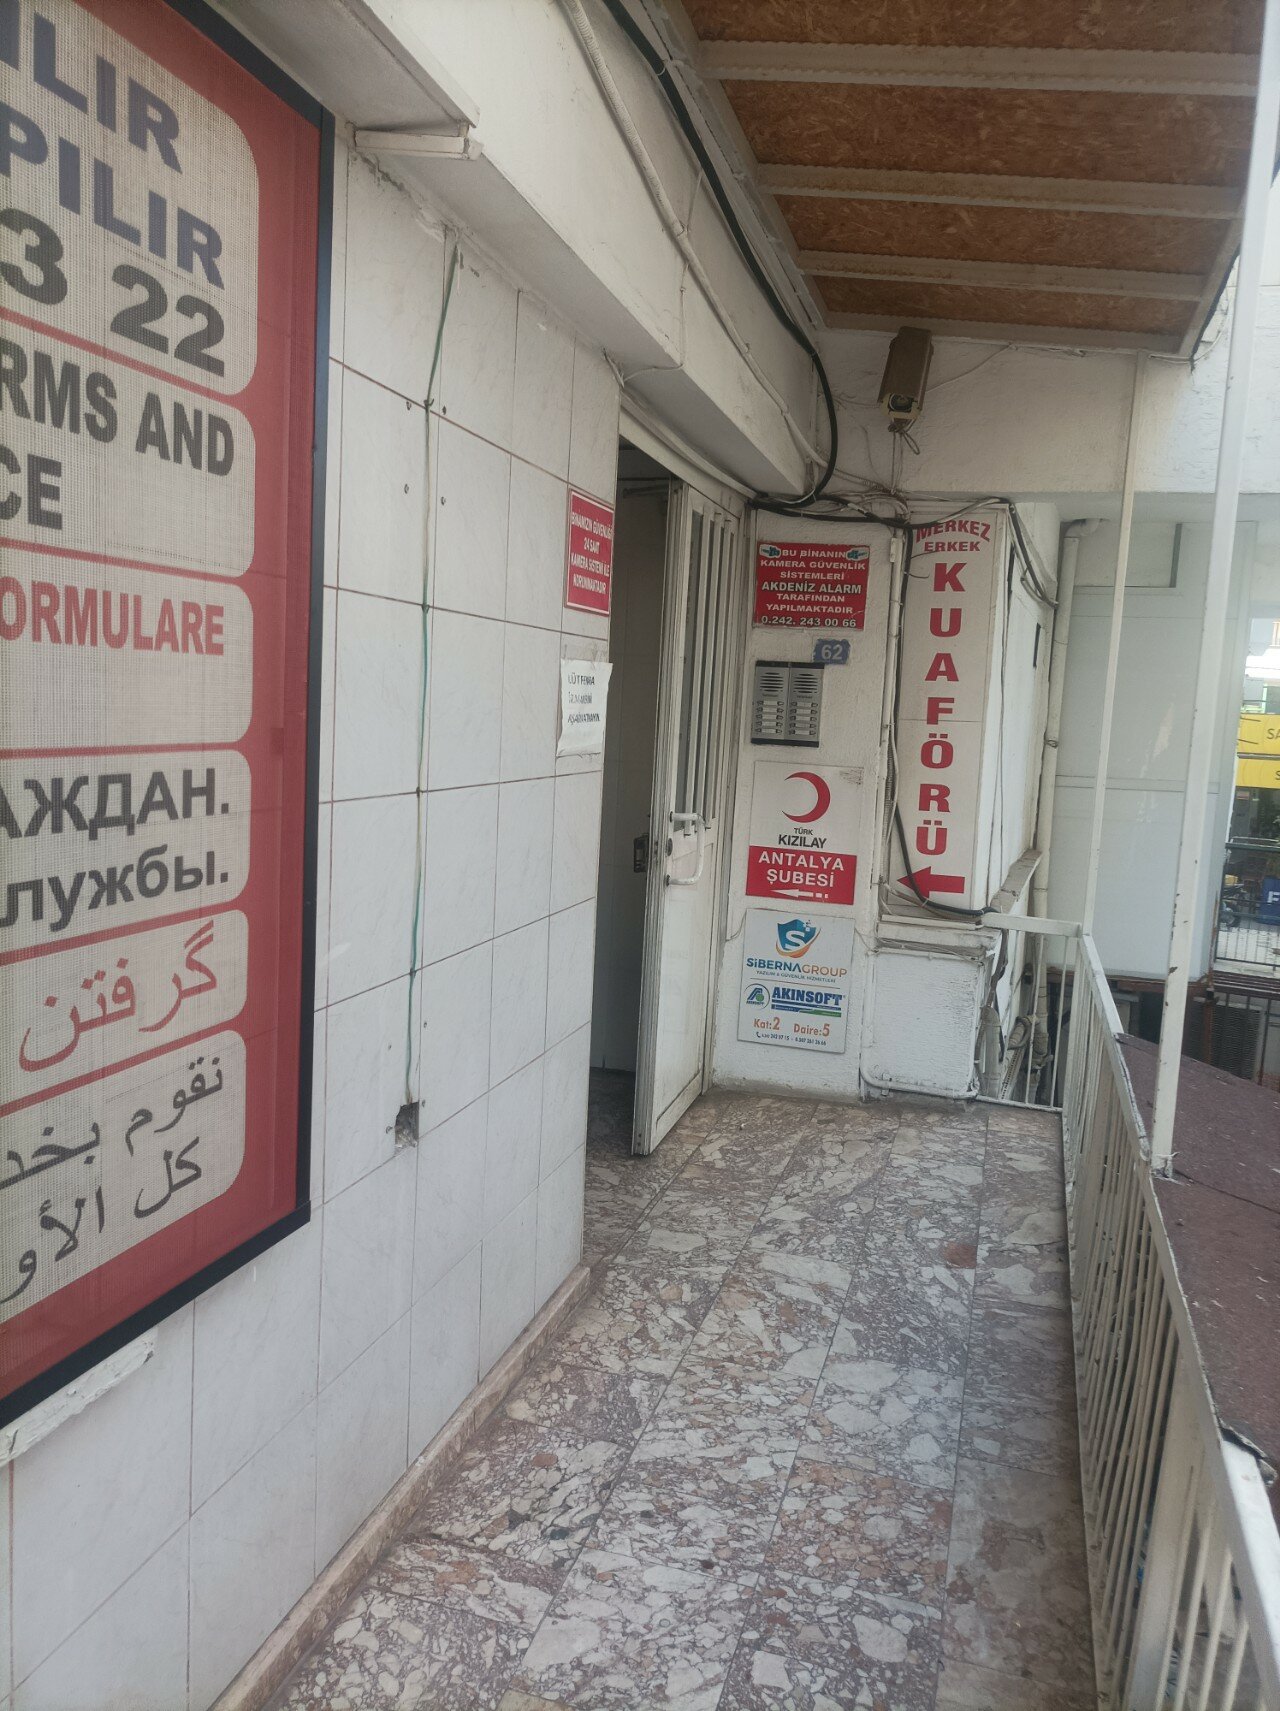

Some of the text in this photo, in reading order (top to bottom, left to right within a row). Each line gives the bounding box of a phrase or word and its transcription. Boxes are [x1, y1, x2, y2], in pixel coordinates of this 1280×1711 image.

[110, 263, 225, 377] 22
[135, 390, 235, 477] AND
[916, 519, 991, 543] MERKEZ
[782, 549, 846, 558] BU BİNANIN
[924, 541, 981, 552] ERKEK
[760, 560, 866, 570] KAMERA GÜVENLİK
[780, 570, 845, 580] SİSTEMLERİ
[762, 581, 862, 594] AKDENİZ ALARM
[776, 593, 845, 603] TARAFINDAN
[766, 603, 853, 614] YAPILMAKTADIR
[800, 616, 820, 626] 243
[825, 618, 838, 627] 00
[842, 619, 856, 627] 66
[821, 644, 843, 660] 62
[915, 562, 967, 856] KUAFÖRÜ
[794, 827, 813, 835] TÜRK
[778, 834, 827, 849] KIZILAY
[758, 851, 844, 871] ANTALYA
[766, 869, 834, 887] ŞUBESİ
[771, 986, 843, 1006] AKINSOFT
[753, 1016, 830, 1037] Kat:2 Daire:5
